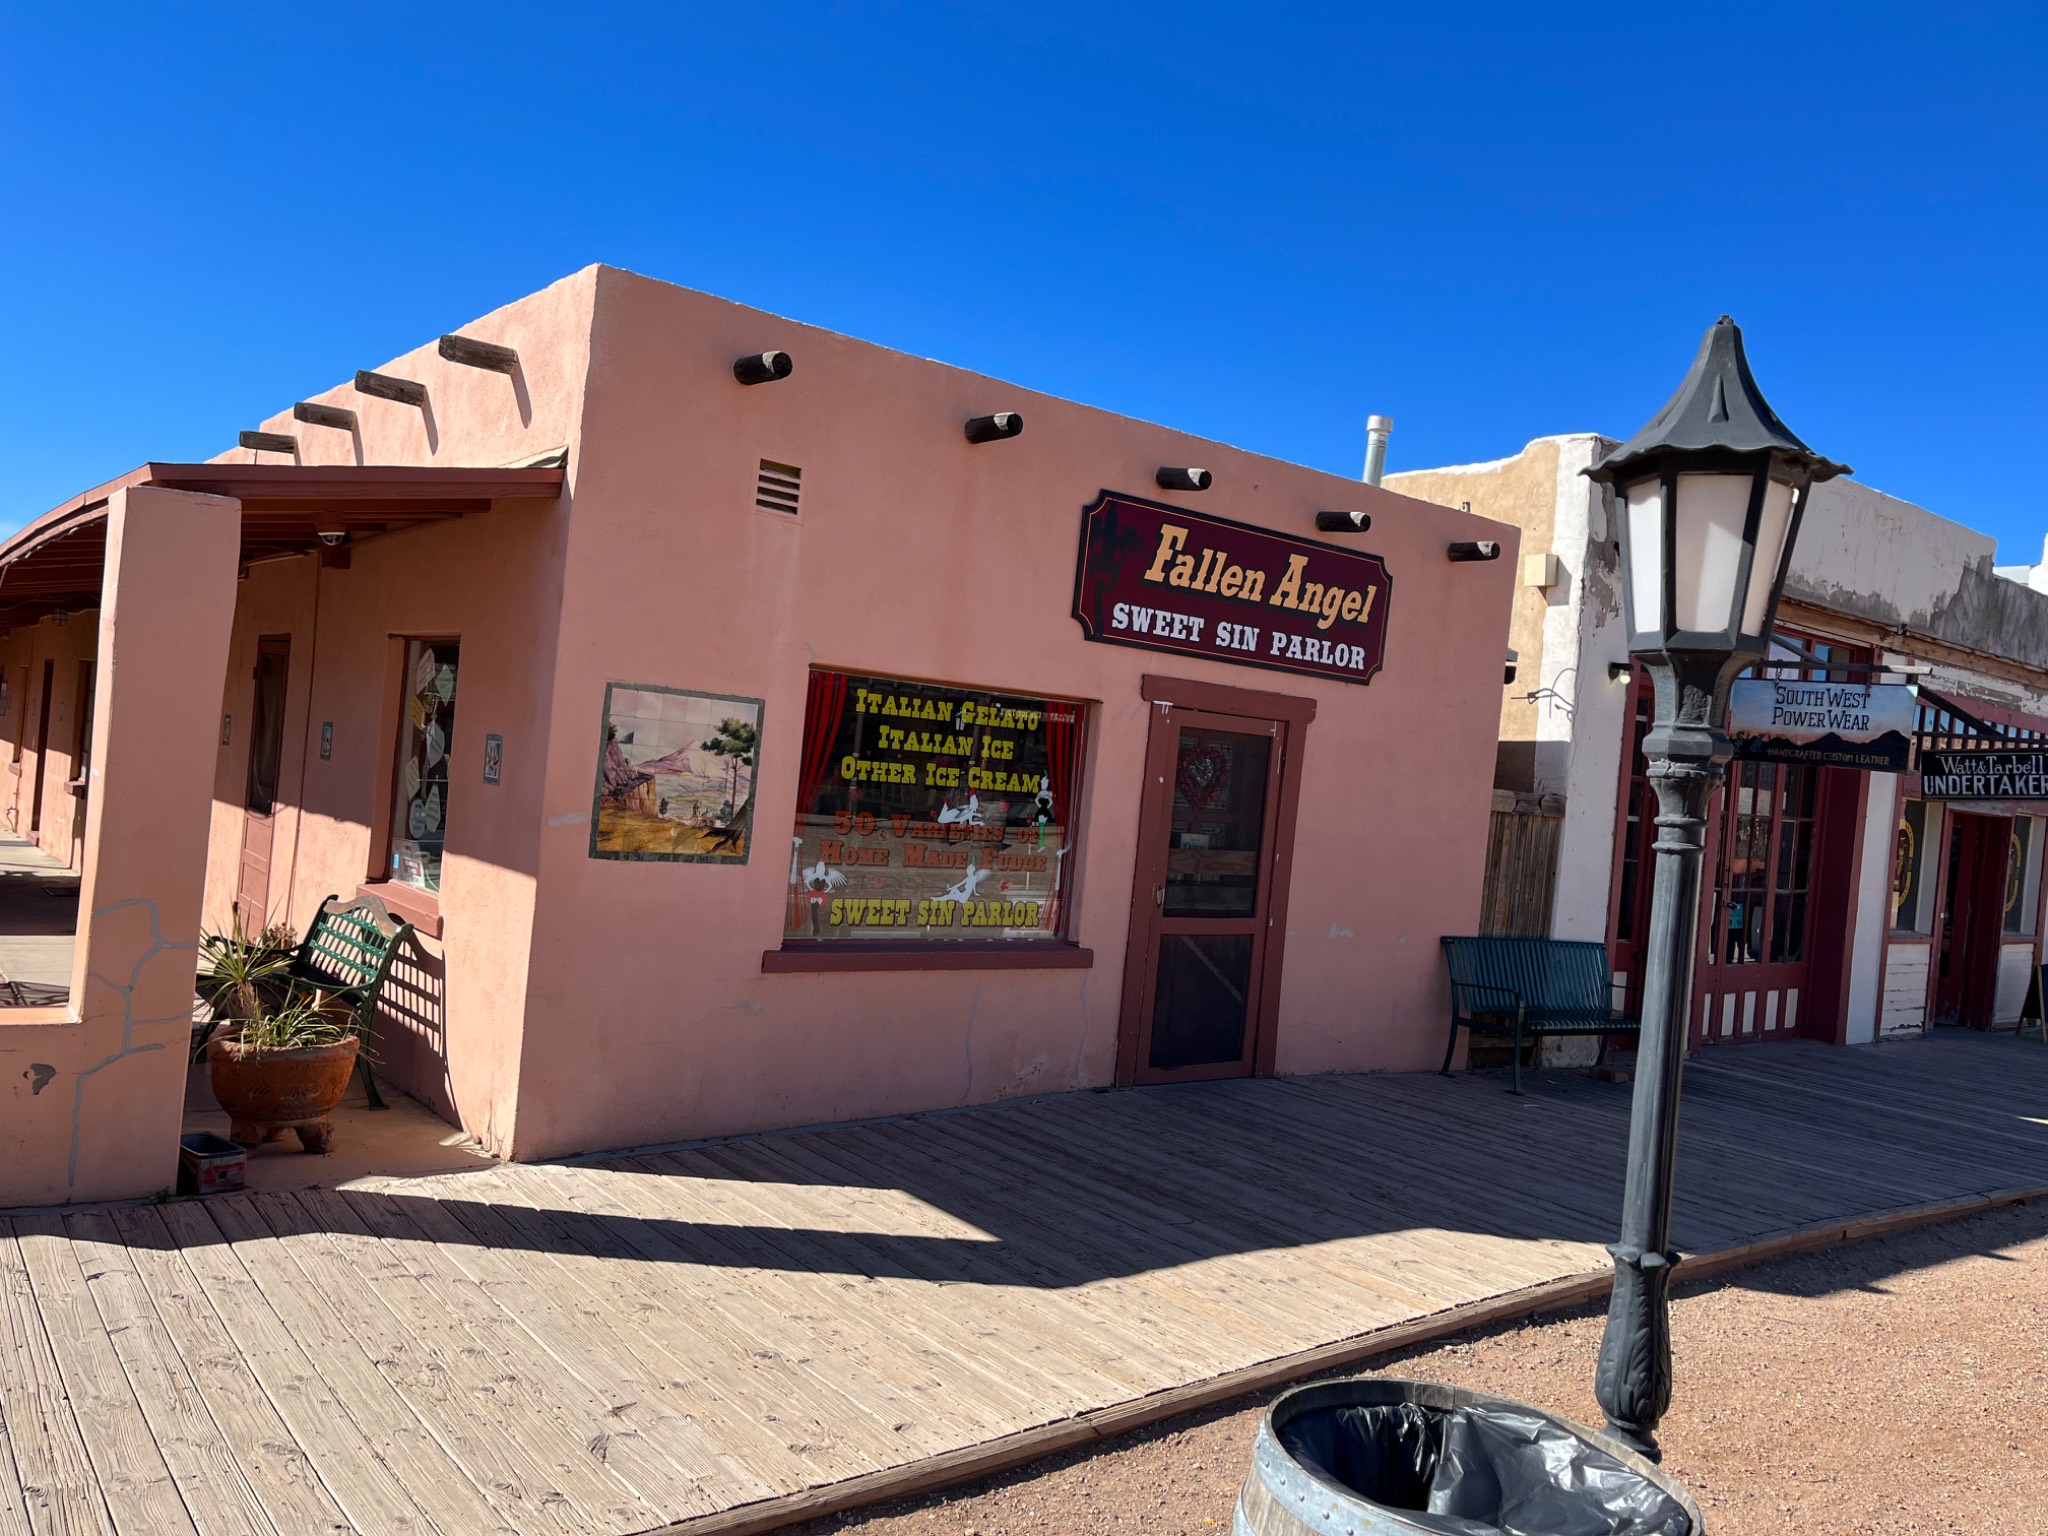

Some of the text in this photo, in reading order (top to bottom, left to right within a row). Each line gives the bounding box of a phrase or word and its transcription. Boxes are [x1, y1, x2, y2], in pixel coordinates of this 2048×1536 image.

[1144, 523, 1377, 630] Fallen Angel
[1111, 602, 1366, 670] SWEET SIN PARLOR
[855, 688, 954, 722] ITALIAN
[961, 701, 1039, 731] GELATO
[878, 725, 1014, 760] ITALIAN ICE
[1767, 747, 1890, 766] HANDCRAFTED CUSTOM LEATHER
[840, 756, 1041, 794] OTHER ICE CREAM
[833, 811, 1041, 844] 50 VARIETIES OF
[820, 839, 1048, 872] HOME MADE FUDGE
[829, 898, 1041, 927] SWEET SIN PARLOR
